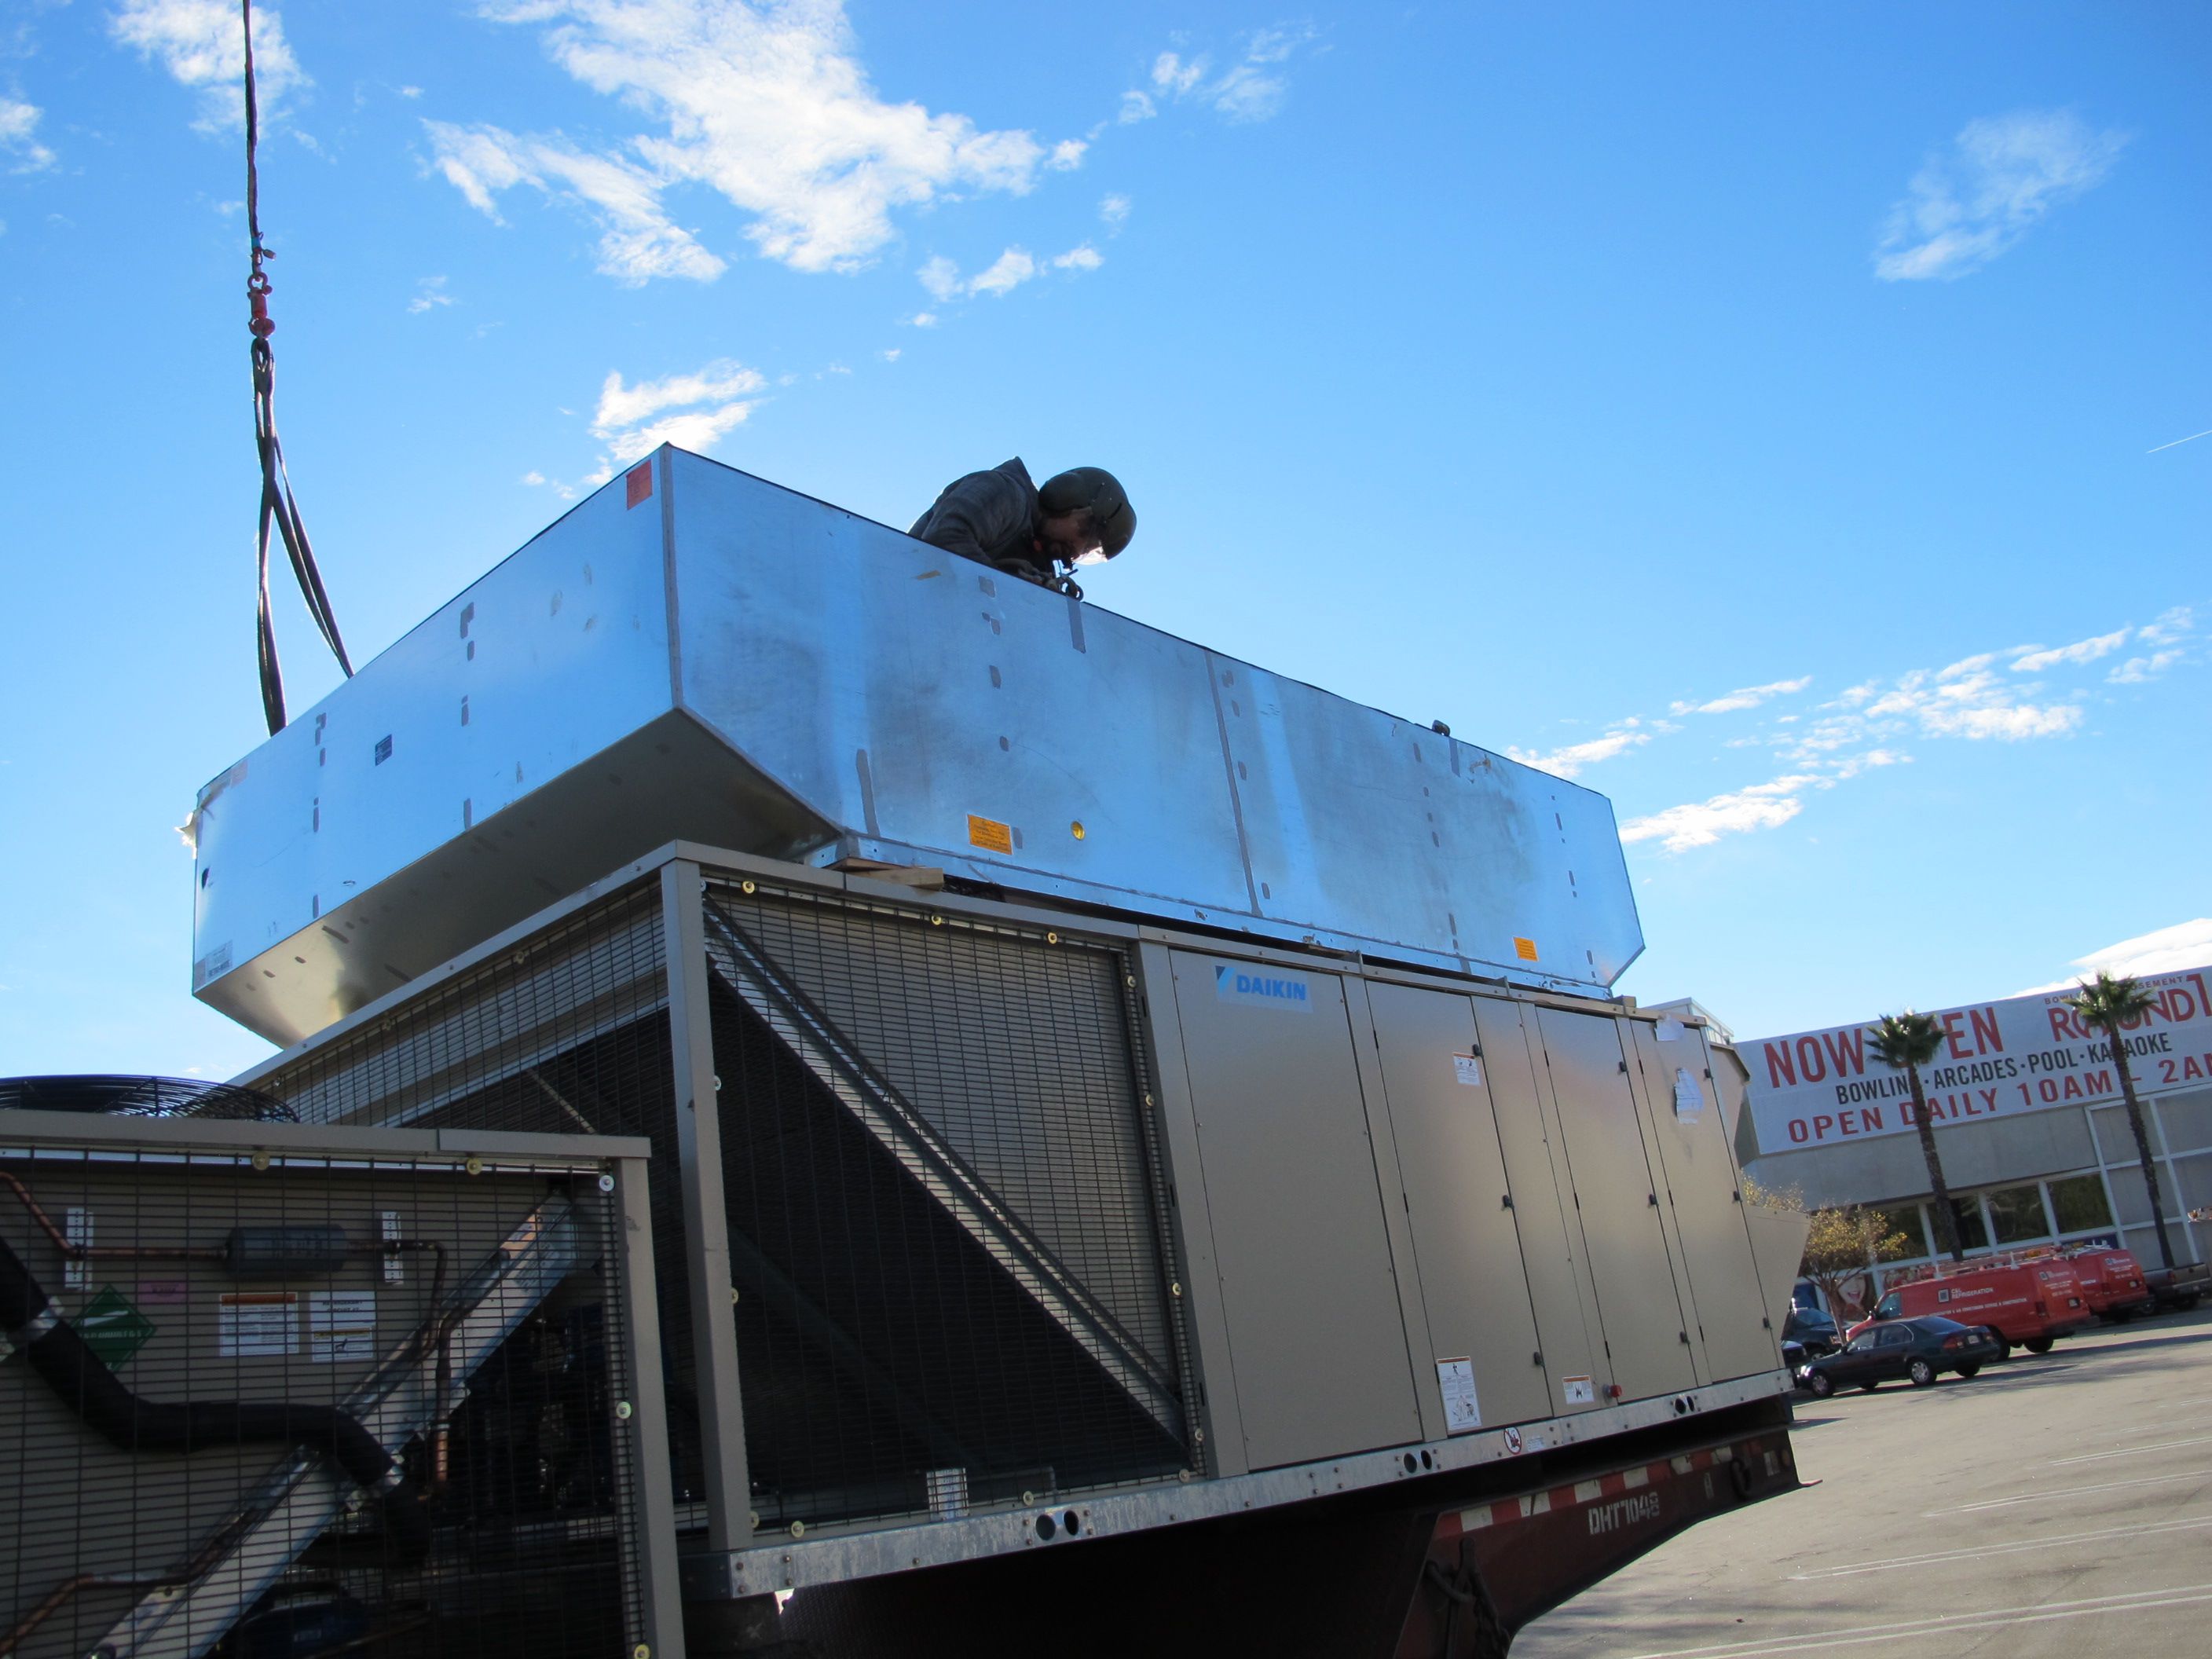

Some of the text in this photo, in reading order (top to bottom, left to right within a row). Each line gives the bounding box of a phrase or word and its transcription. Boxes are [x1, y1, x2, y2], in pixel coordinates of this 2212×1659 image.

[1236, 975, 1306, 1001] DAIKIN
[1763, 1027, 1865, 1089] NOW
[1836, 1031, 2173, 1105] BOWLIN ARCADES POOL KAAOKE
[1788, 1106, 1884, 1143] OPEN
[1899, 1087, 1998, 1126] DAILY
[2016, 1069, 2113, 1107] 10AM
